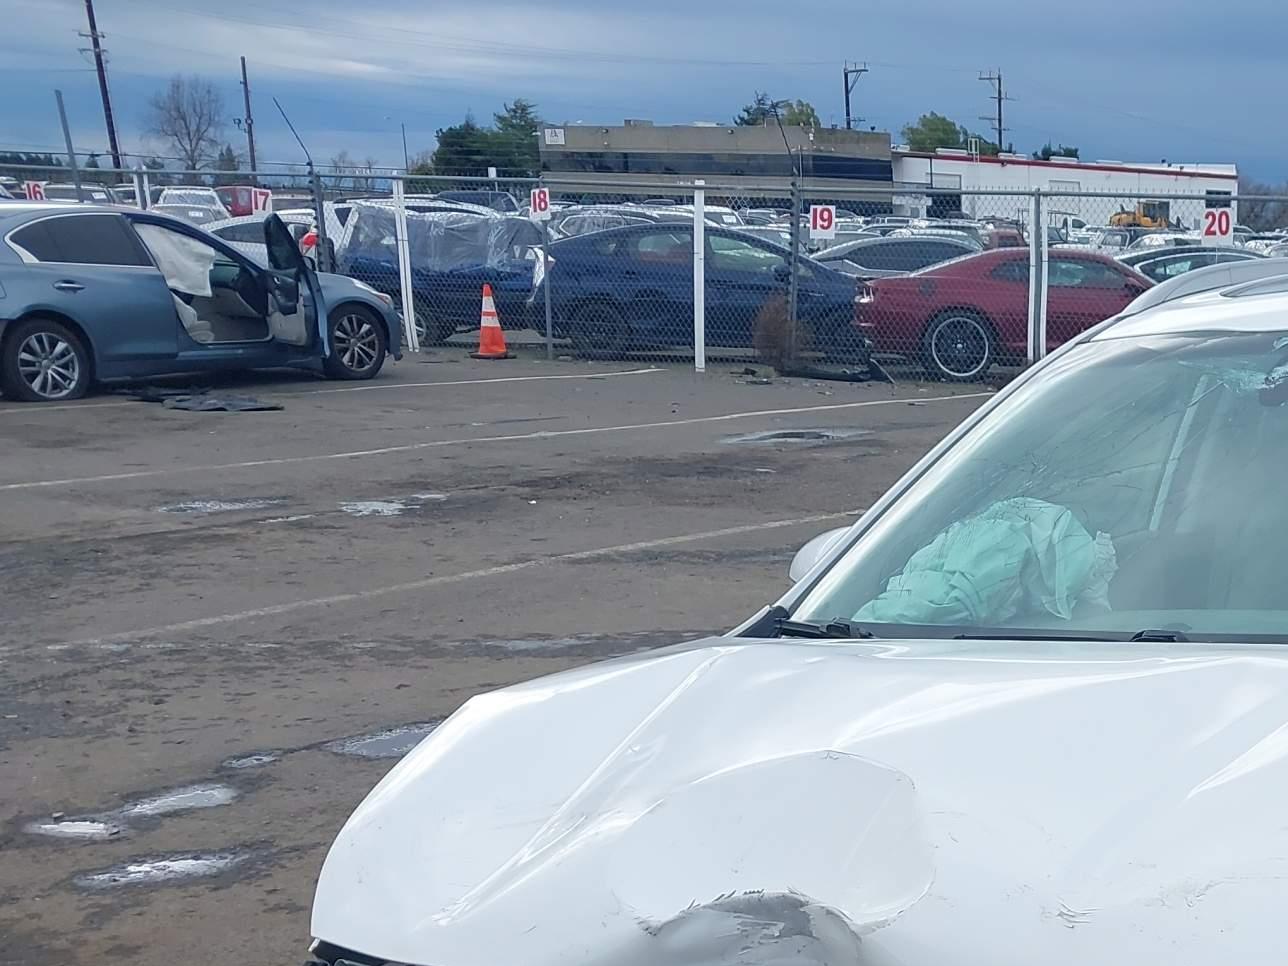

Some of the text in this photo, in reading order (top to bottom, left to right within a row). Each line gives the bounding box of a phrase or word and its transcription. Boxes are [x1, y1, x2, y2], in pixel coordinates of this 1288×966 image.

[26, 183, 44, 200] 16
[254, 190, 270, 211] 17
[532, 190, 548, 212] 18
[812, 207, 833, 230] 19
[1204, 210, 1230, 236] 20
